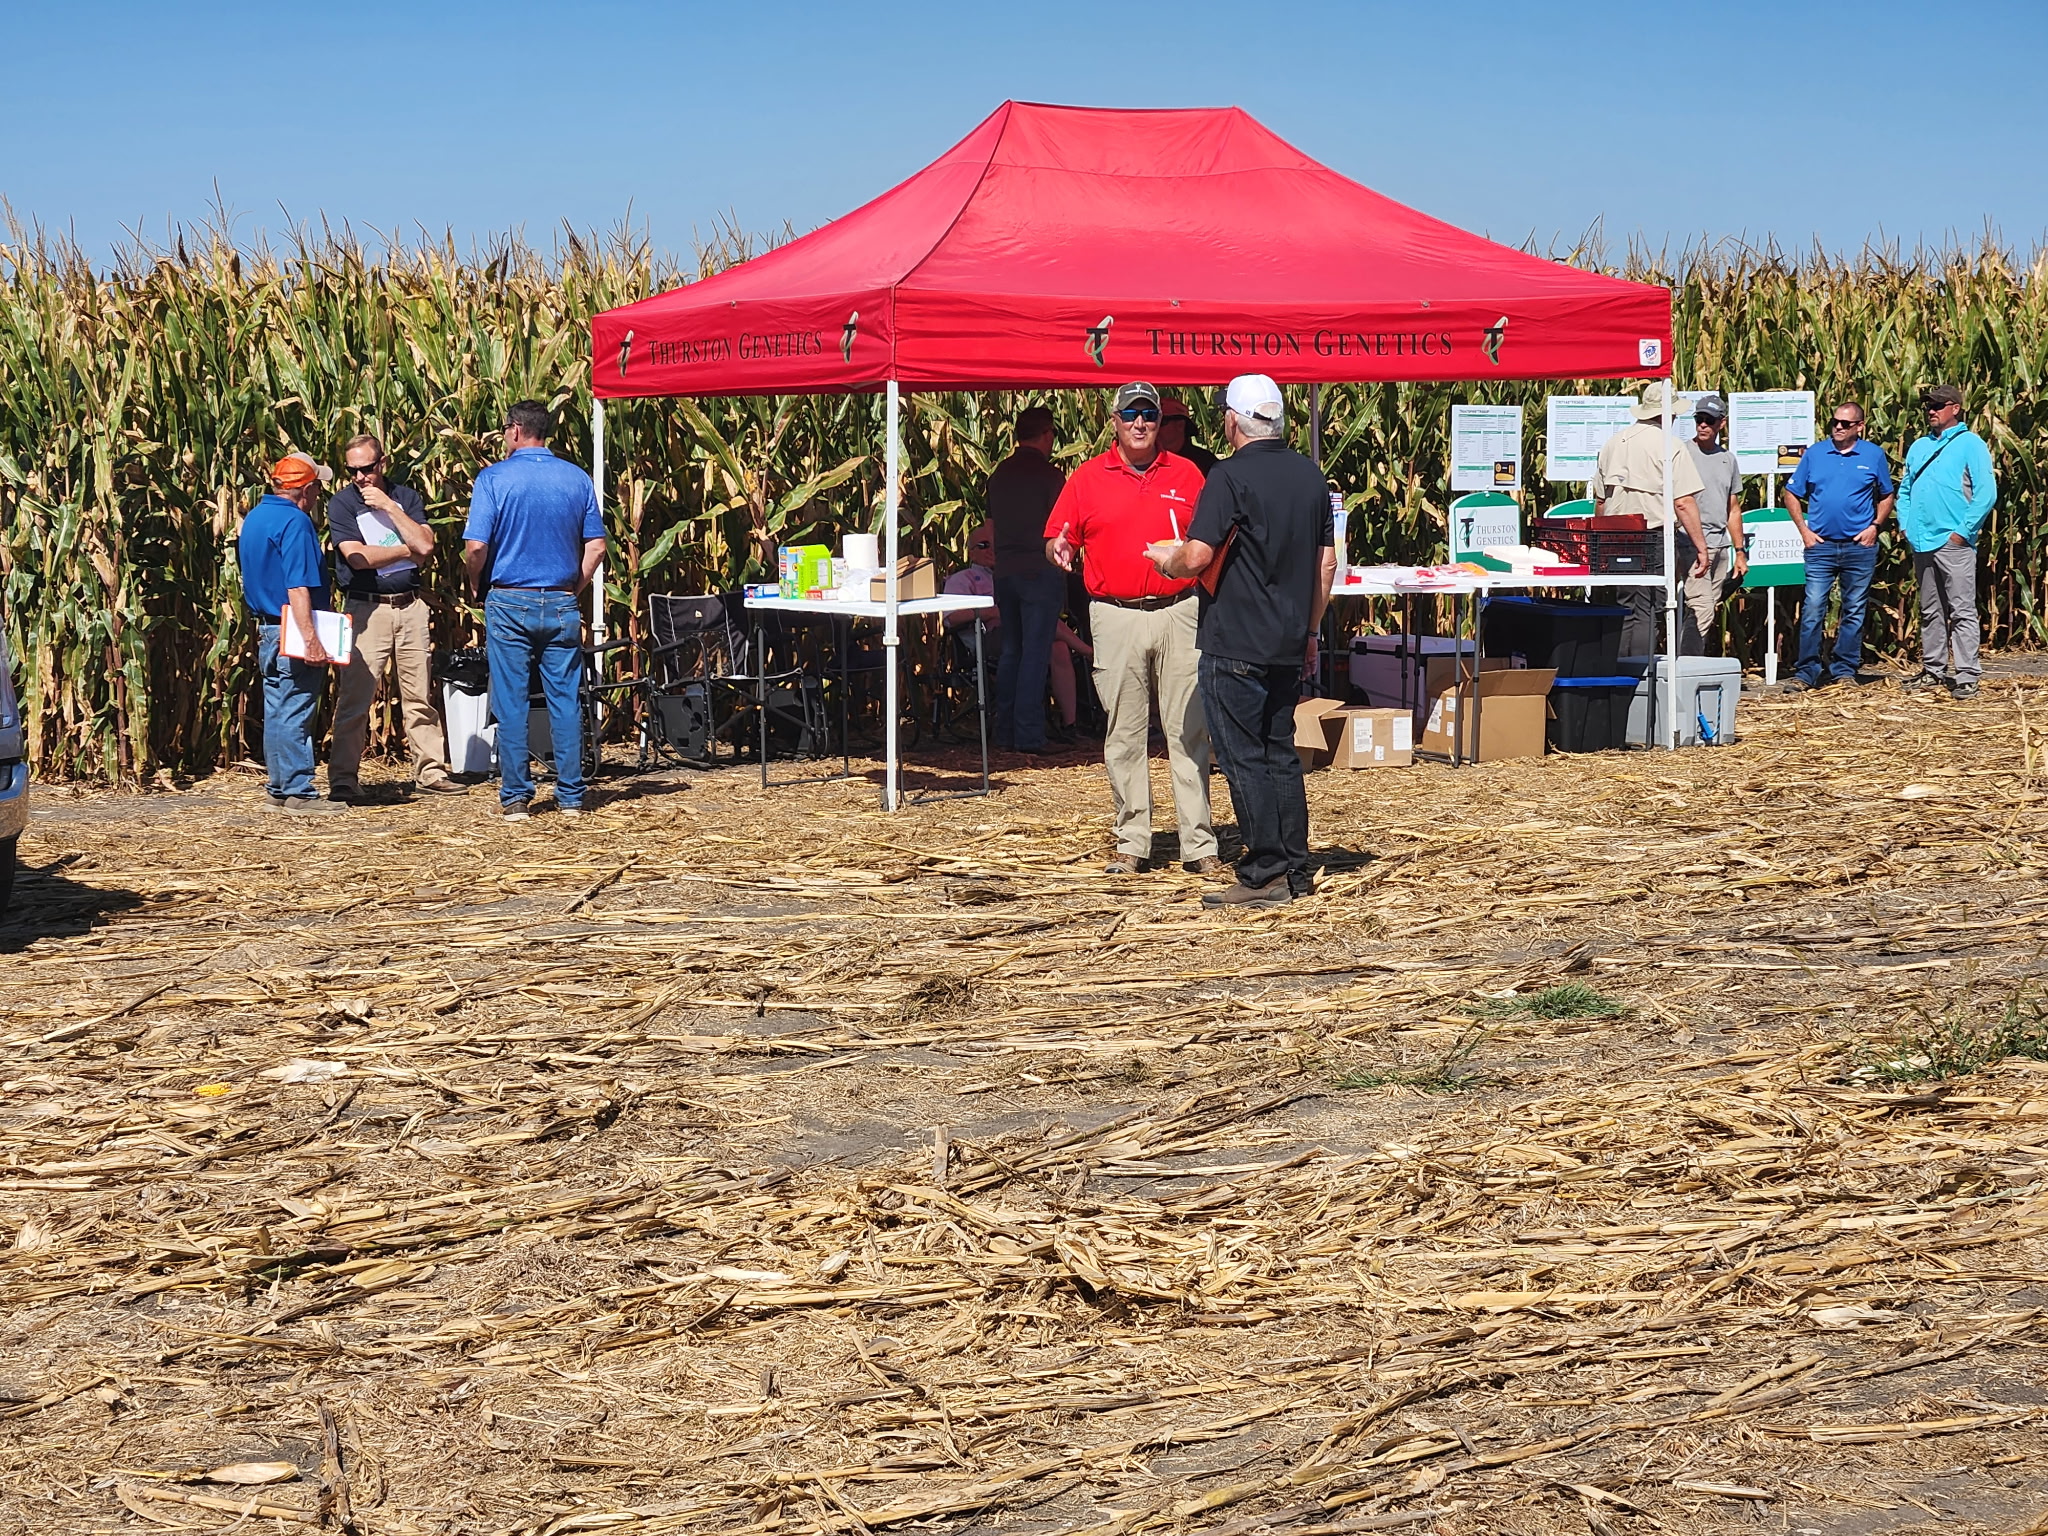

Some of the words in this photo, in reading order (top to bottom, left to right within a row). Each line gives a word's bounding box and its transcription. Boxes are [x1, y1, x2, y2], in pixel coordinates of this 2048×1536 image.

[649, 338, 732, 366] THURSTON
[739, 331, 823, 360] GENETICS
[1145, 329, 1301, 357] THURSTON
[1314, 329, 1453, 357] GENETICS
[1476, 524, 1517, 535] THURSTON
[1476, 536, 1514, 546] GENETICS
[1758, 539, 1803, 549] THURSTO
